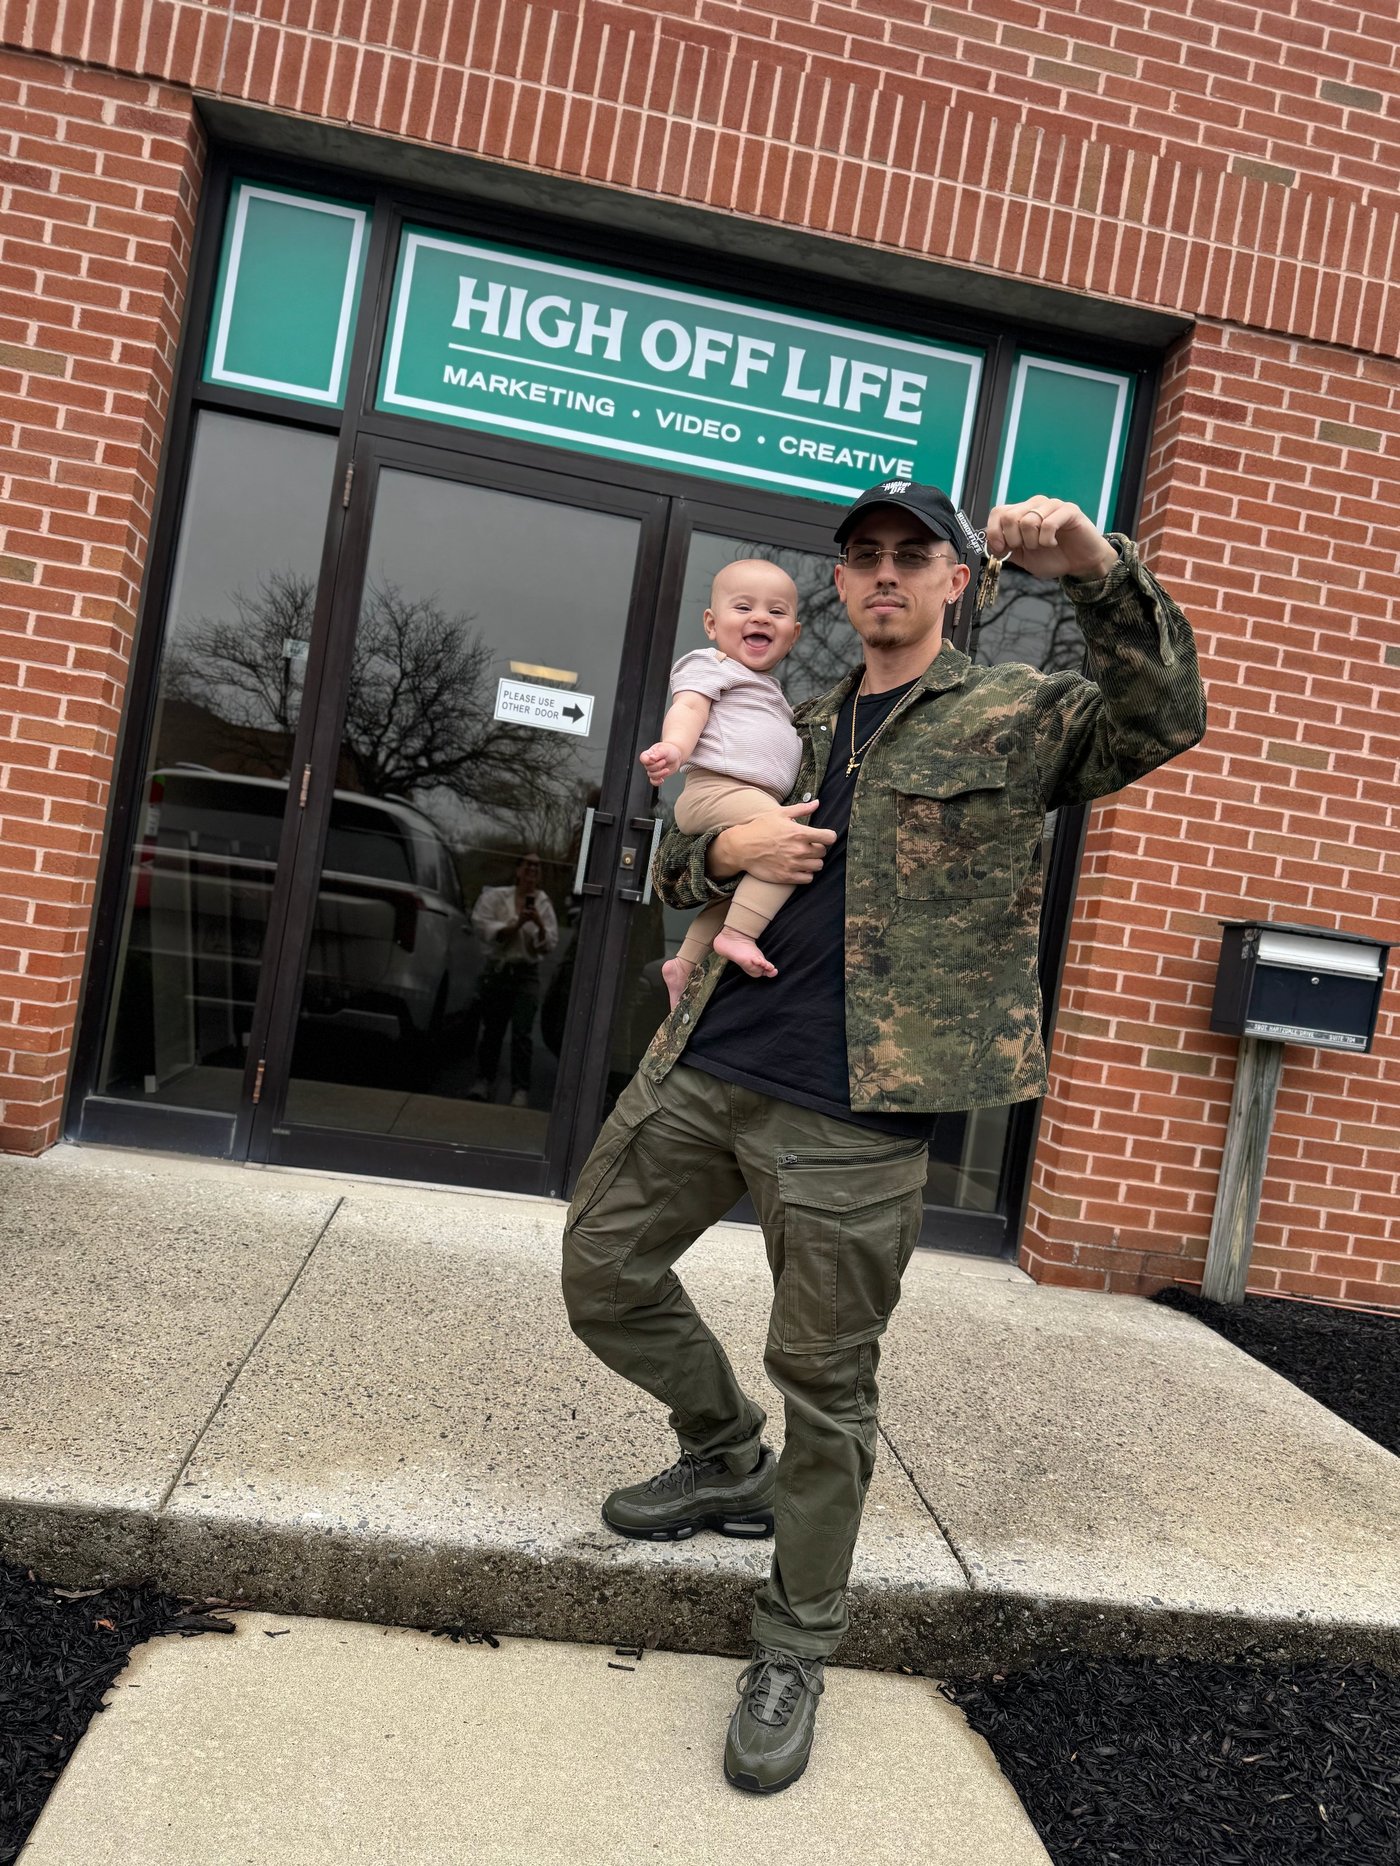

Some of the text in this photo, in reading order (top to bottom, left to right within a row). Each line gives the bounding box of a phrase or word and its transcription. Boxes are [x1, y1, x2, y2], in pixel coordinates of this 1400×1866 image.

[451, 275, 928, 425] HIGH OFF LIFE
[442, 364, 914, 479] MARKETING VIDEO CREATIVE
[889, 486, 906, 495] LIFE
[503, 690, 555, 708] PLEASE USE
[502, 701, 559, 720] OTHER DOOR
[1329, 1034, 1344, 1043] SUITE
